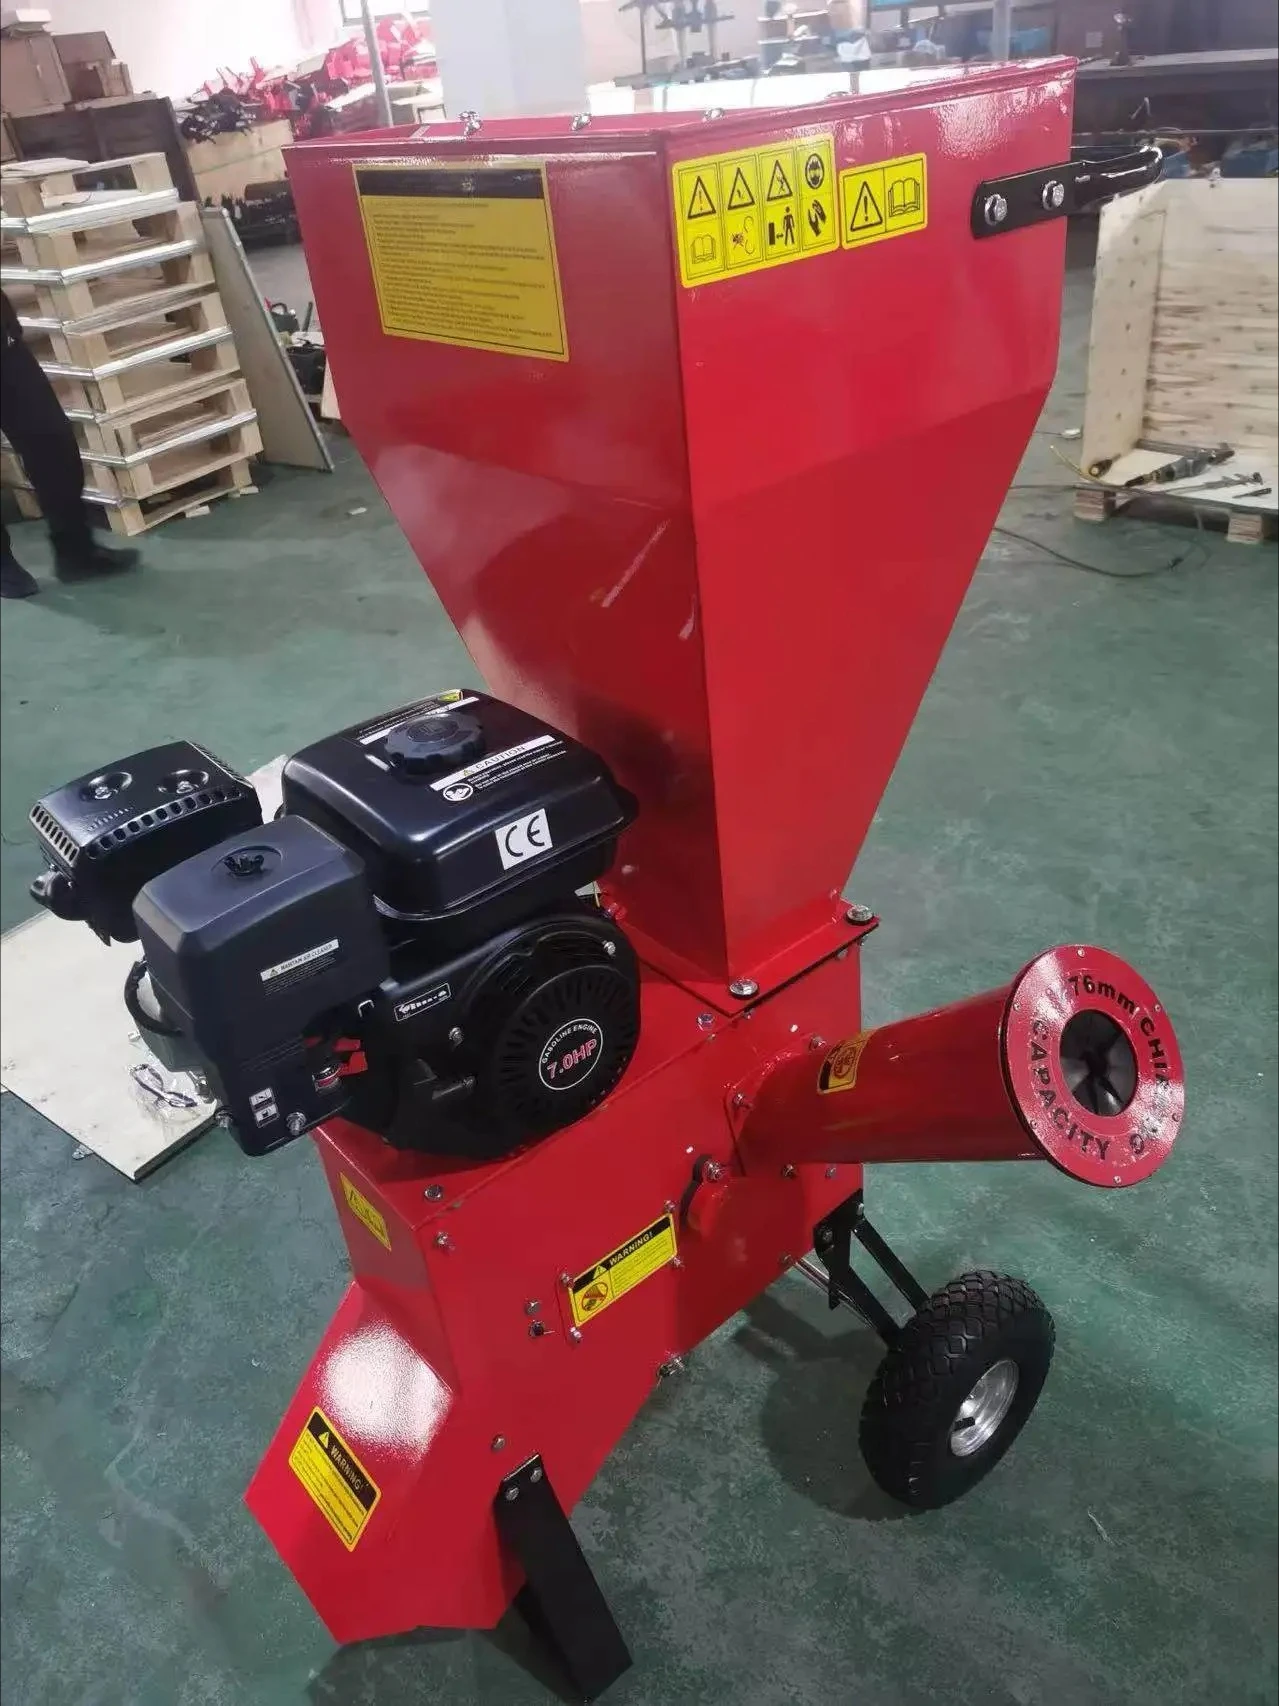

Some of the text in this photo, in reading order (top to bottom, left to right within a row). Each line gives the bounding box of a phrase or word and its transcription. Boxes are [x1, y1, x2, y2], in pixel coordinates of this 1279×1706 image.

[476, 746, 526, 770] CAUTION
[504, 815, 545, 858] CE
[1068, 975, 1136, 1016] 76mm
[573, 1023, 598, 1034] ENGINE
[546, 1038, 597, 1079] 7.0HP
[1031, 1020, 1111, 1160] CAPACITY
[609, 1231, 653, 1266] WARNING!
